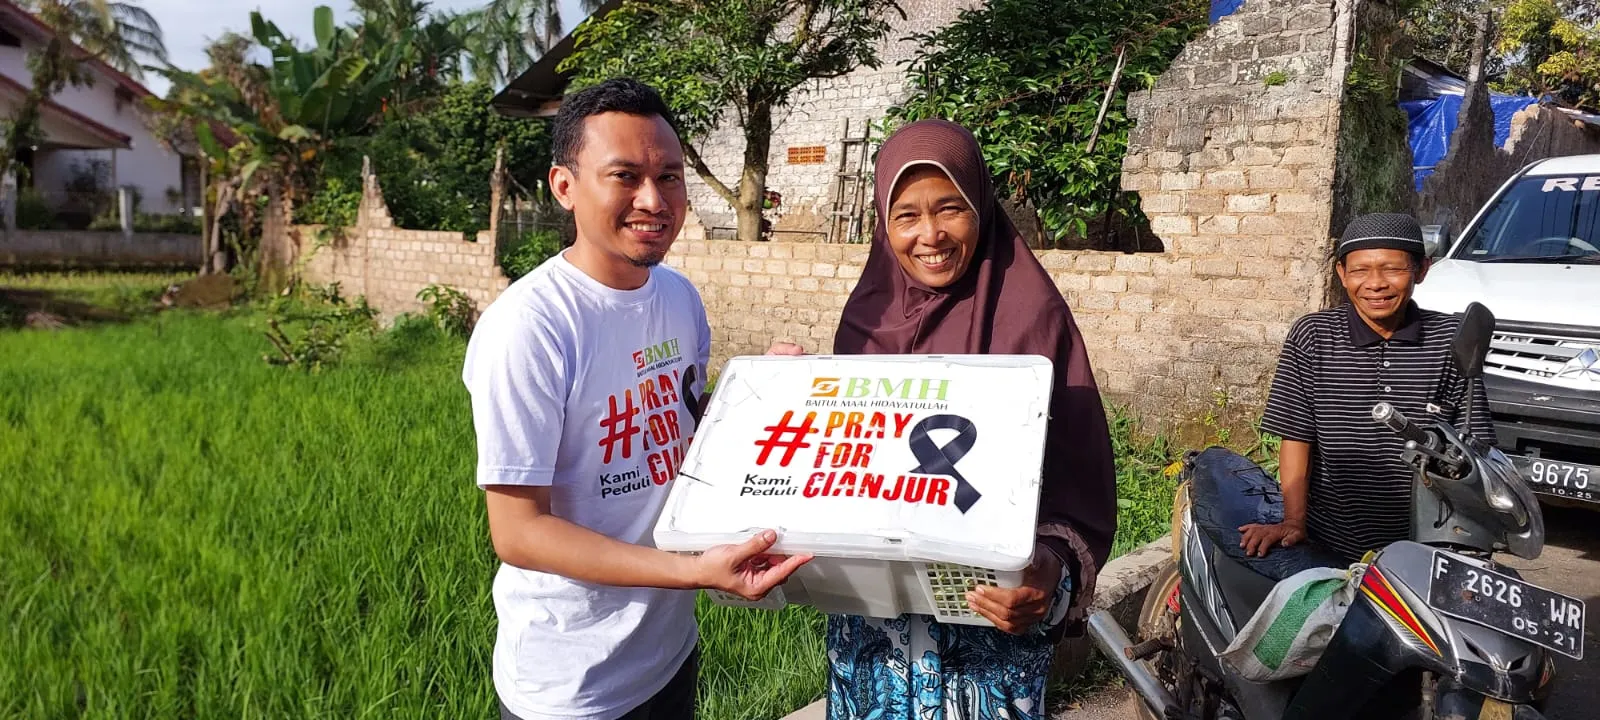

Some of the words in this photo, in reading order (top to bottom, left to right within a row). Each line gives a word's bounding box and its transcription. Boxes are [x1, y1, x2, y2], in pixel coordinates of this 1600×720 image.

[644, 338, 681, 365] BMH
[843, 377, 952, 401] BMH
[805, 399, 838, 408] BAITUL
[840, 400, 867, 408] MAAL
[870, 400, 948, 411] HIDAYATULLAH
[824, 411, 913, 439] PRAY
[813, 442, 873, 468] FOR
[600, 465, 640, 486] Kami
[602, 475, 650, 499] Peduli
[744, 473, 792, 485] Kami
[1531, 461, 1590, 489] 9675
[740, 486, 799, 497] Peduli
[803, 471, 950, 506] CIANJUR
[1436, 557, 1449, 579] F
[1466, 570, 1522, 608] 2626
[1550, 598, 1581, 630] WR
